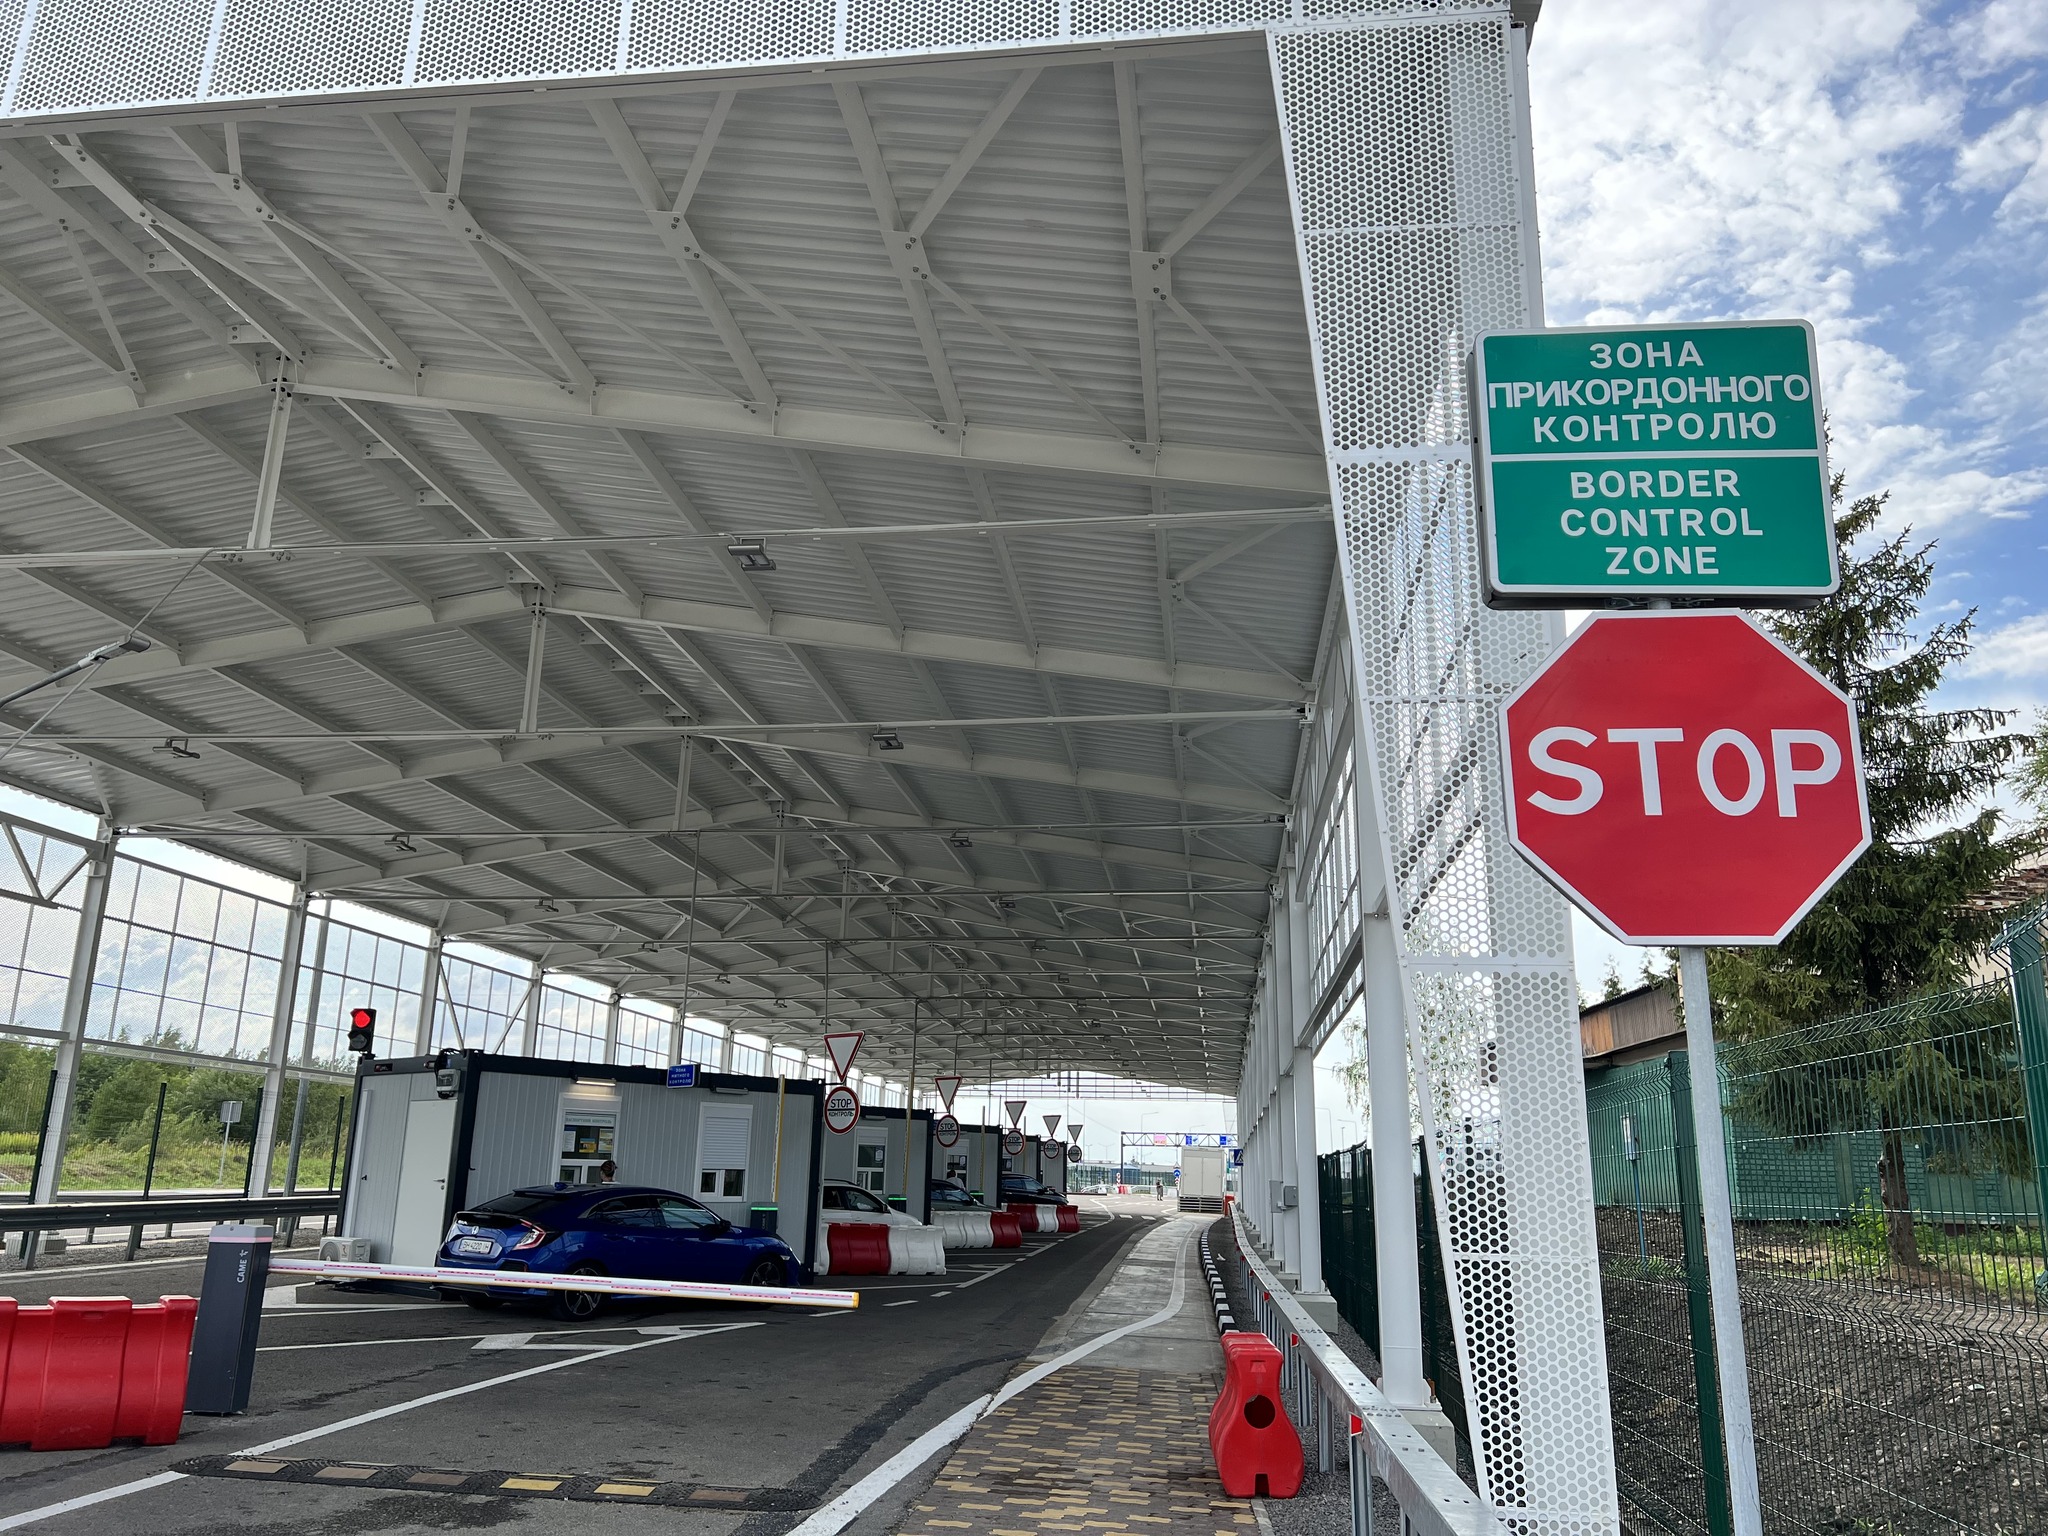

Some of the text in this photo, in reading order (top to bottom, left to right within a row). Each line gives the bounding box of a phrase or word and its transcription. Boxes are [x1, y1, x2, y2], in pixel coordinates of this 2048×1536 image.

[1590, 341, 1704, 369] ЗОНА
[1488, 374, 1810, 409] ПРИКОРДОННОГО
[1533, 412, 1777, 443] КОНТРОЛЮ
[1570, 469, 1741, 499] BORDER
[1560, 508, 1764, 537] CONTROL
[1605, 546, 1720, 575] ZONE
[1527, 726, 1842, 818] STOP
[830, 1098, 852, 1108] STOP
[940, 1122, 955, 1130] STOP
[236, 1259, 248, 1283] CAME
